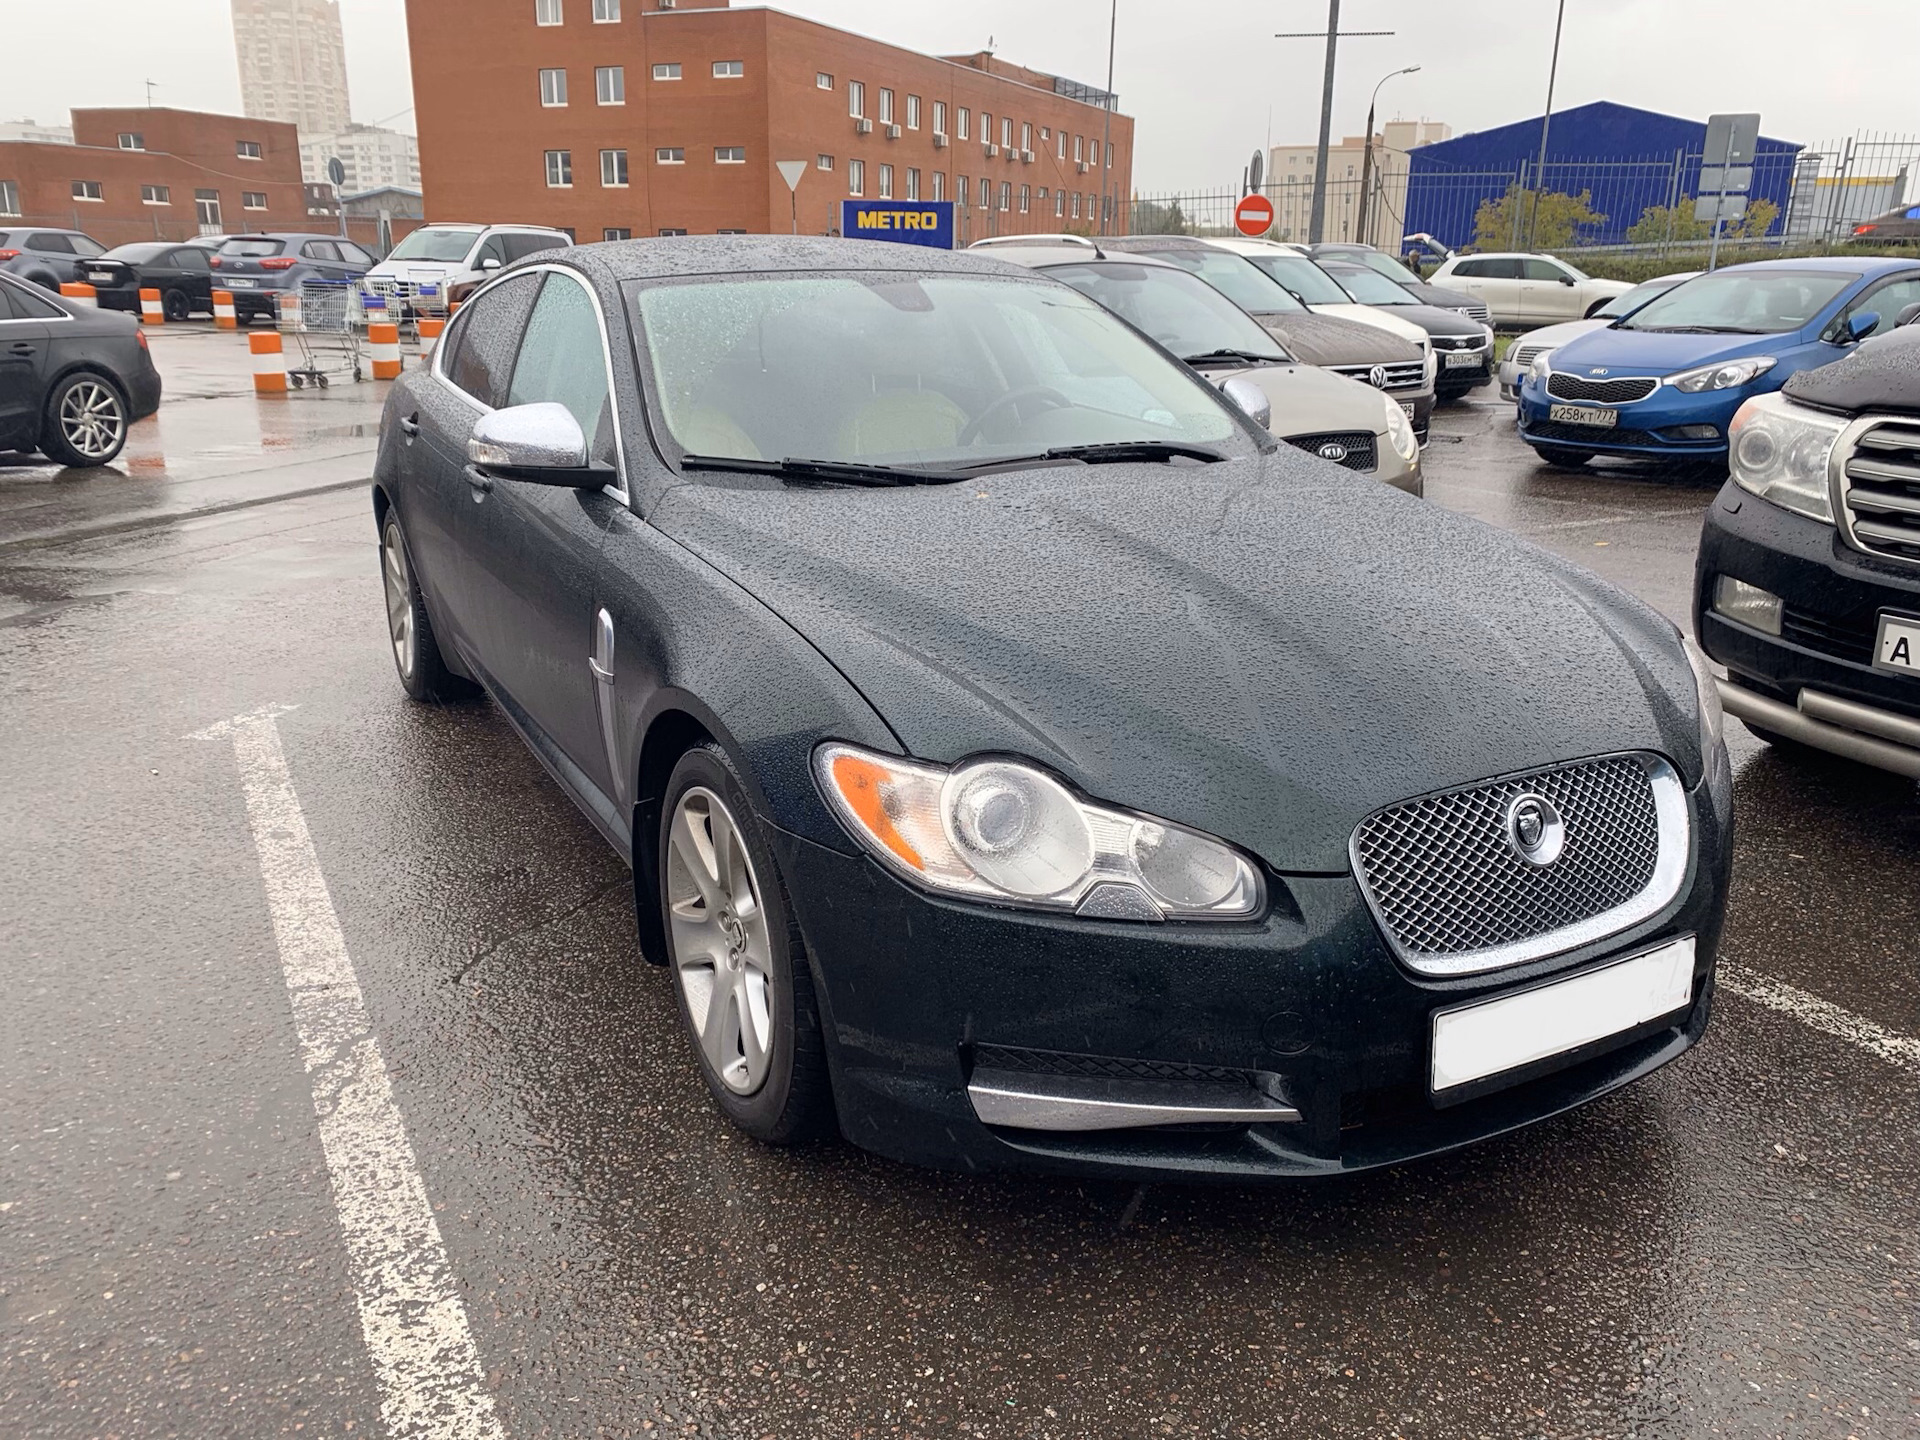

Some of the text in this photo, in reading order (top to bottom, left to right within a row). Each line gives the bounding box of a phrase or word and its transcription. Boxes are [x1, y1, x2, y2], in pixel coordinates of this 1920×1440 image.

[857, 210, 938, 230] METRO
[1400, 404, 1412, 416] 99
[1596, 409, 1614, 421] 777
[1323, 447, 1344, 459] KIA
